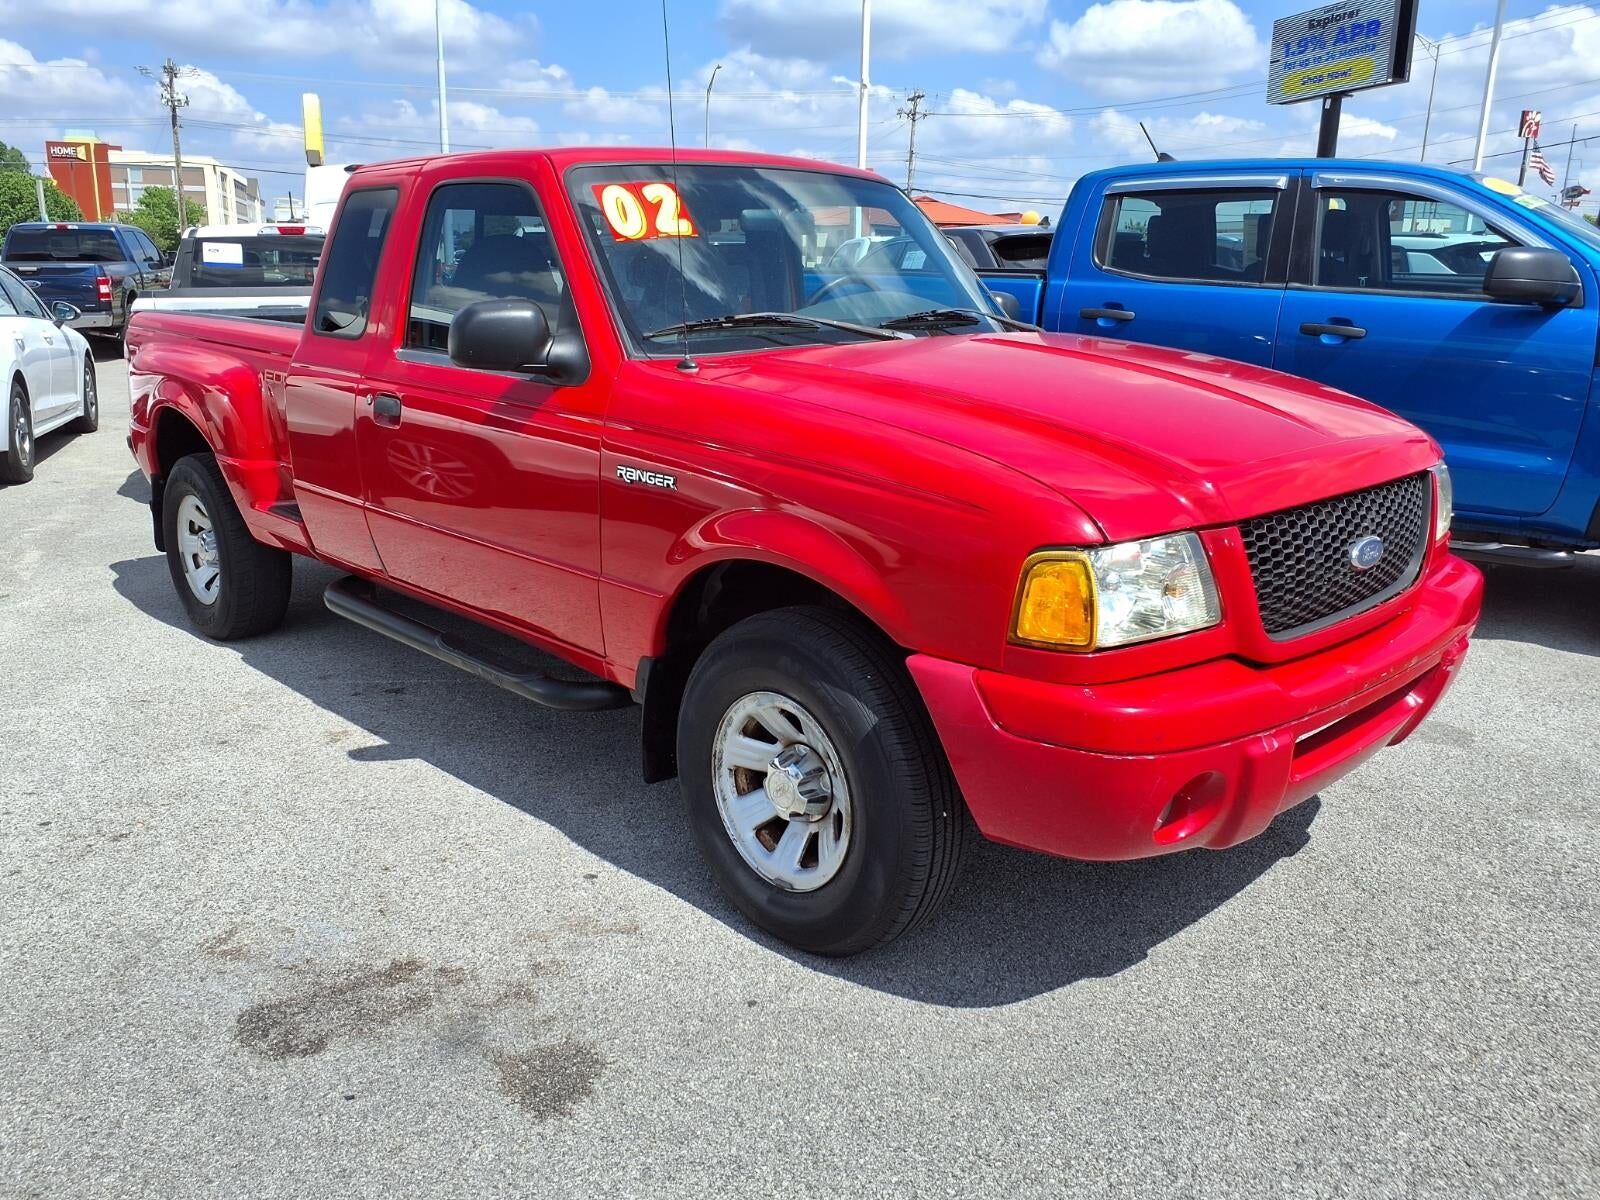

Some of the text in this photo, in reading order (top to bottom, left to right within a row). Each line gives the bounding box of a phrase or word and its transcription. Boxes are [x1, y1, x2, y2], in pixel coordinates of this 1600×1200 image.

[1308, 9, 1361, 30] Explorer
[1284, 19, 1382, 58] 1.9% APR
[50, 146, 76, 155] HOME
[602, 183, 693, 240] 02
[617, 465, 678, 491] RANGER
